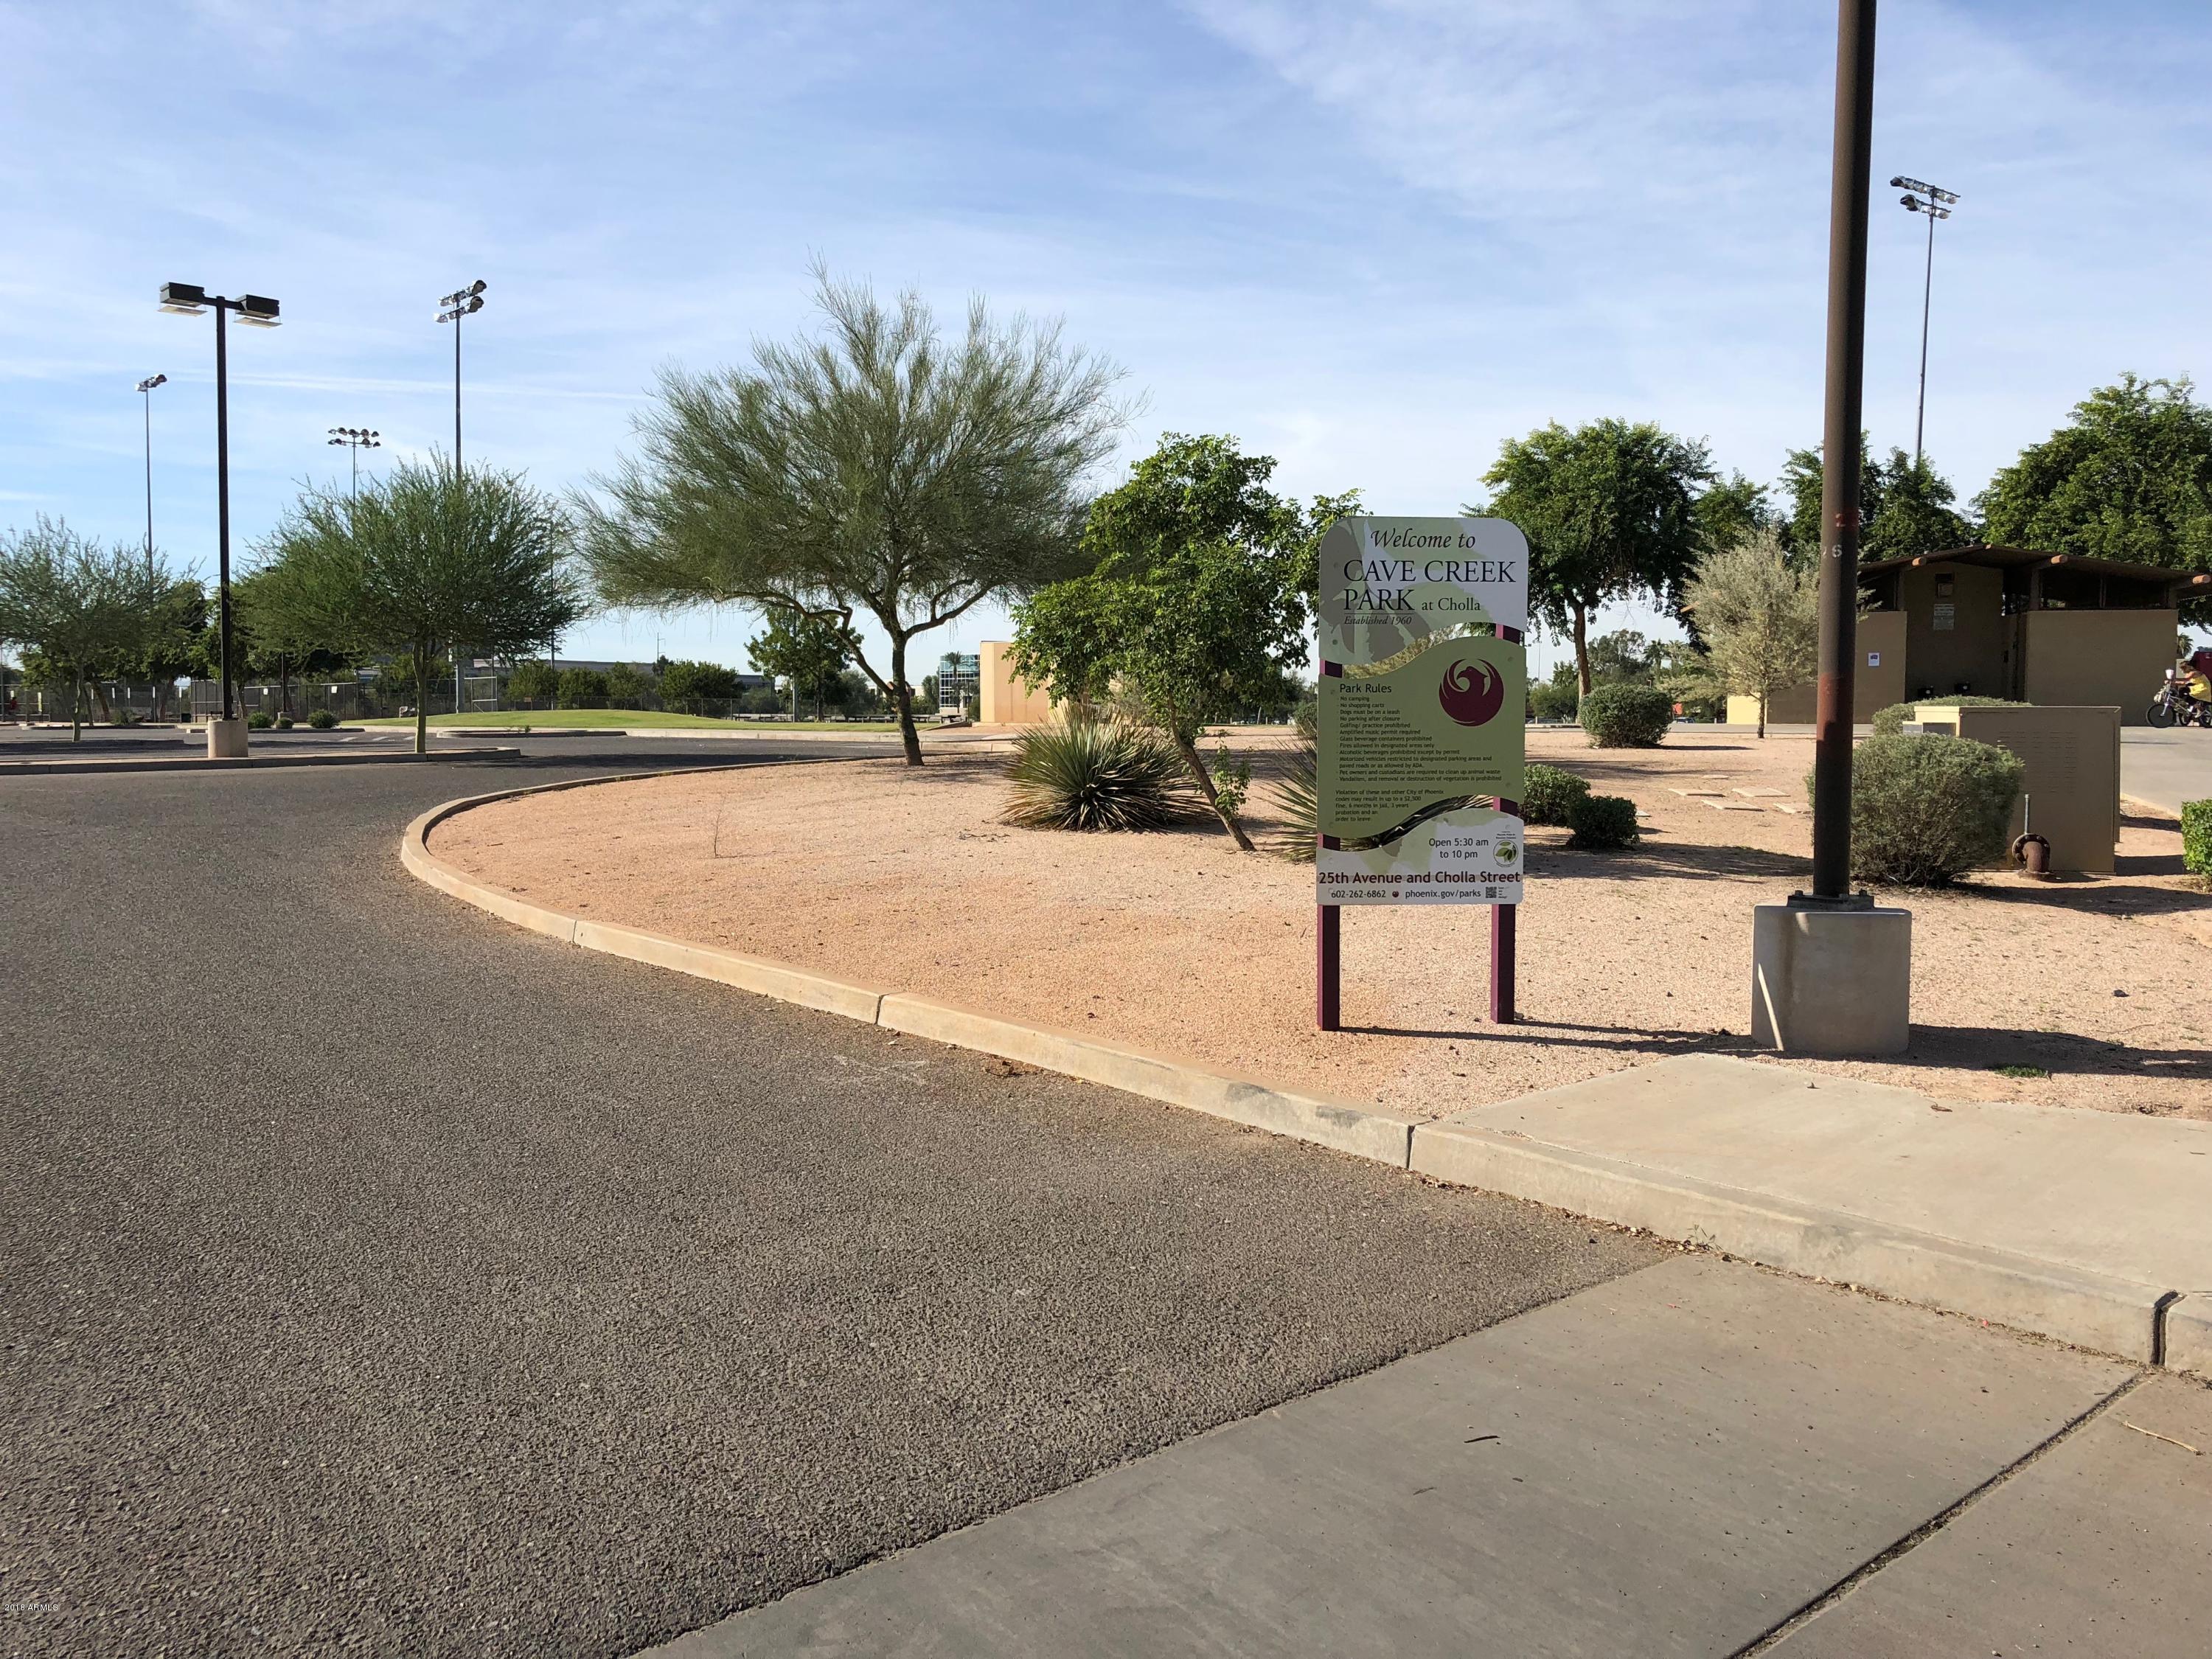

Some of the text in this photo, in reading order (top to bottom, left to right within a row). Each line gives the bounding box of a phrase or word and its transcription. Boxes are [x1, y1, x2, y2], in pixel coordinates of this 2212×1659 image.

[1371, 528, 1475, 548] Welcome to
[1343, 560, 1516, 582] CAVE CREEK
[1343, 589, 1481, 611] PARK at Cholla
[1344, 616, 1412, 625] Established 1960
[1340, 684, 1392, 693] Park Rules
[1429, 838, 1451, 847] Open
[1454, 838, 1472, 846] 5:30
[1453, 850, 1461, 858] 10
[1464, 852, 1478, 860] pm
[1319, 872, 1520, 884] 25th Avenue and Cholla Street
[1331, 890, 1386, 898] 602-262-6862
[1405, 889, 1481, 898] phoenix.gov/parks
